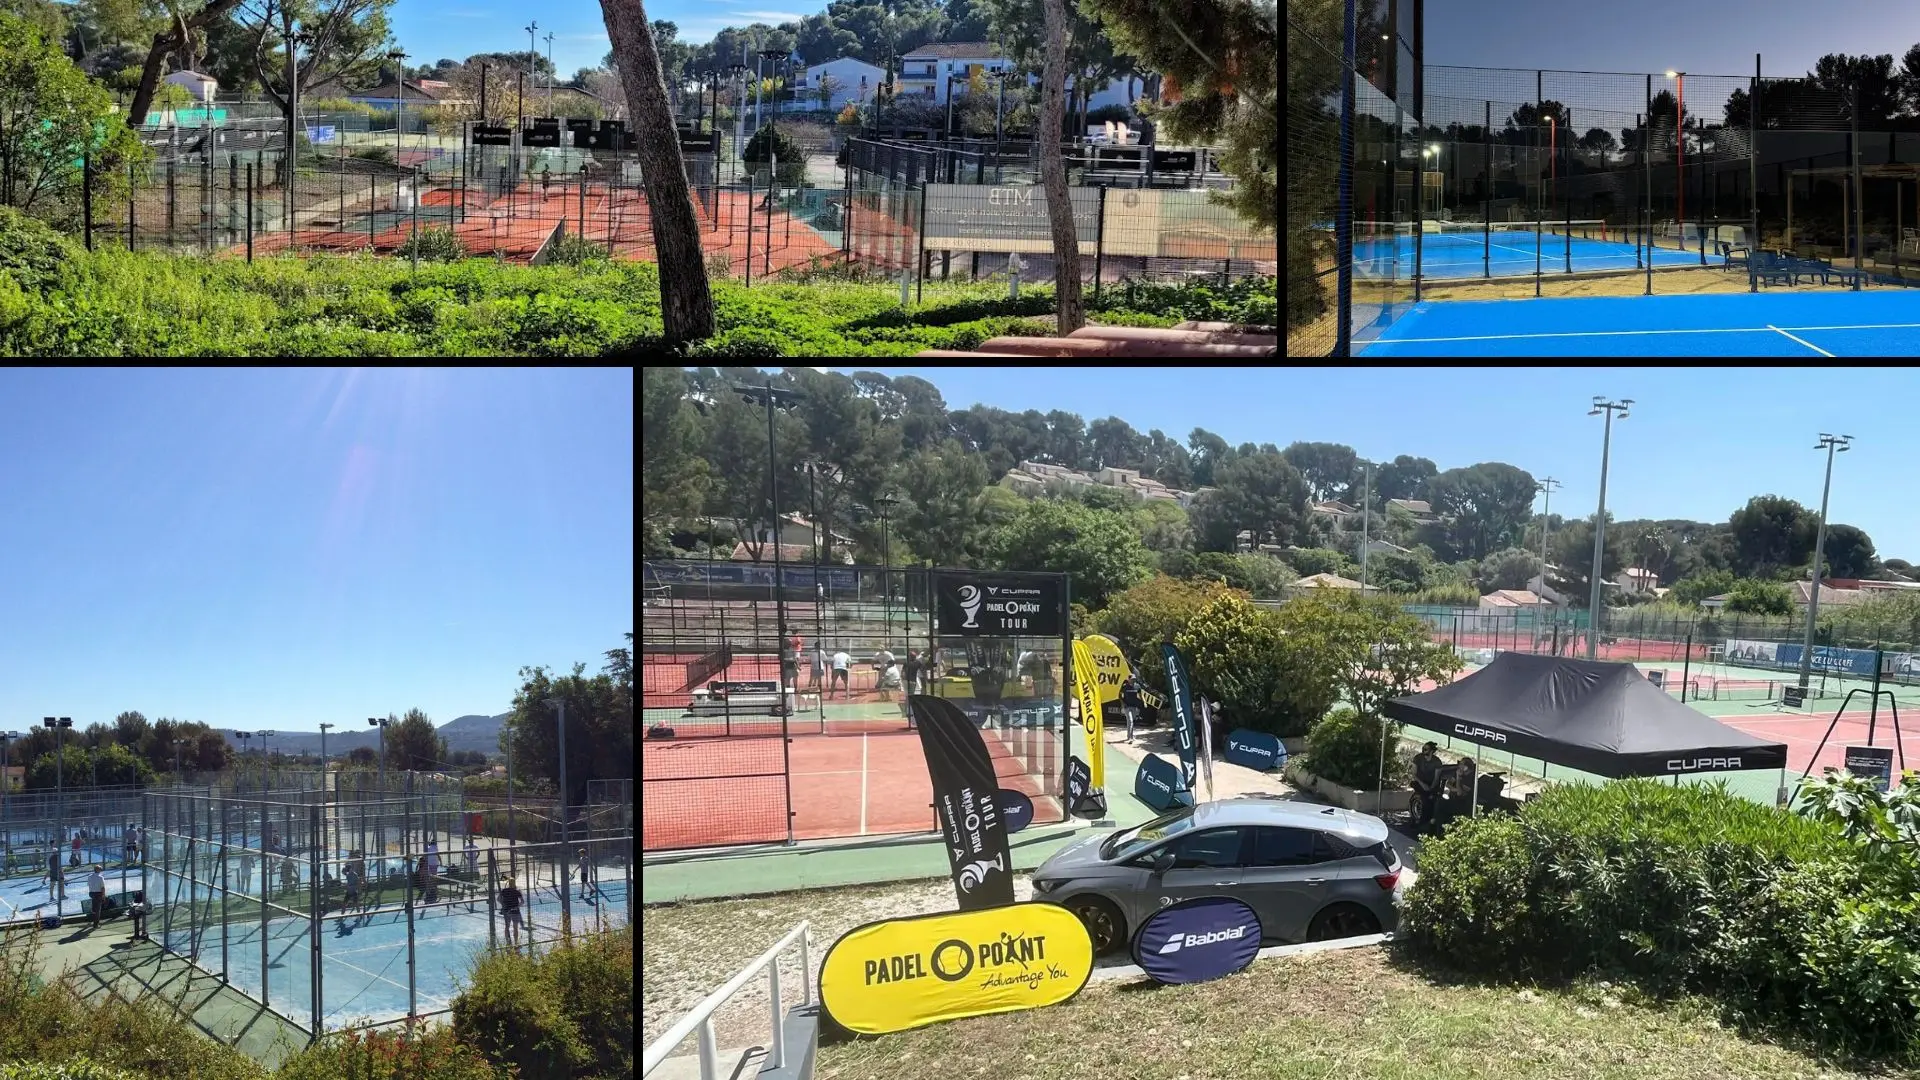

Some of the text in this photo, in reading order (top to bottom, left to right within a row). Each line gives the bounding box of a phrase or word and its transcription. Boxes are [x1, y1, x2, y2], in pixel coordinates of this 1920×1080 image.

[986, 603, 1005, 612] PADEL
[1000, 618, 1028, 628] TOUR
[1168, 655, 1190, 749] CUPRA
[1454, 723, 1507, 744] CUPRA
[1239, 744, 1272, 757] CUPRA
[1666, 757, 1742, 771] CUPRA
[1147, 775, 1170, 794] CUPRA
[944, 794, 960, 844] CUPRA
[980, 795, 997, 830] TOUR
[970, 829, 983, 854] PADEL
[864, 953, 927, 986] PADEL
[980, 962, 1069, 990] Advantage You
